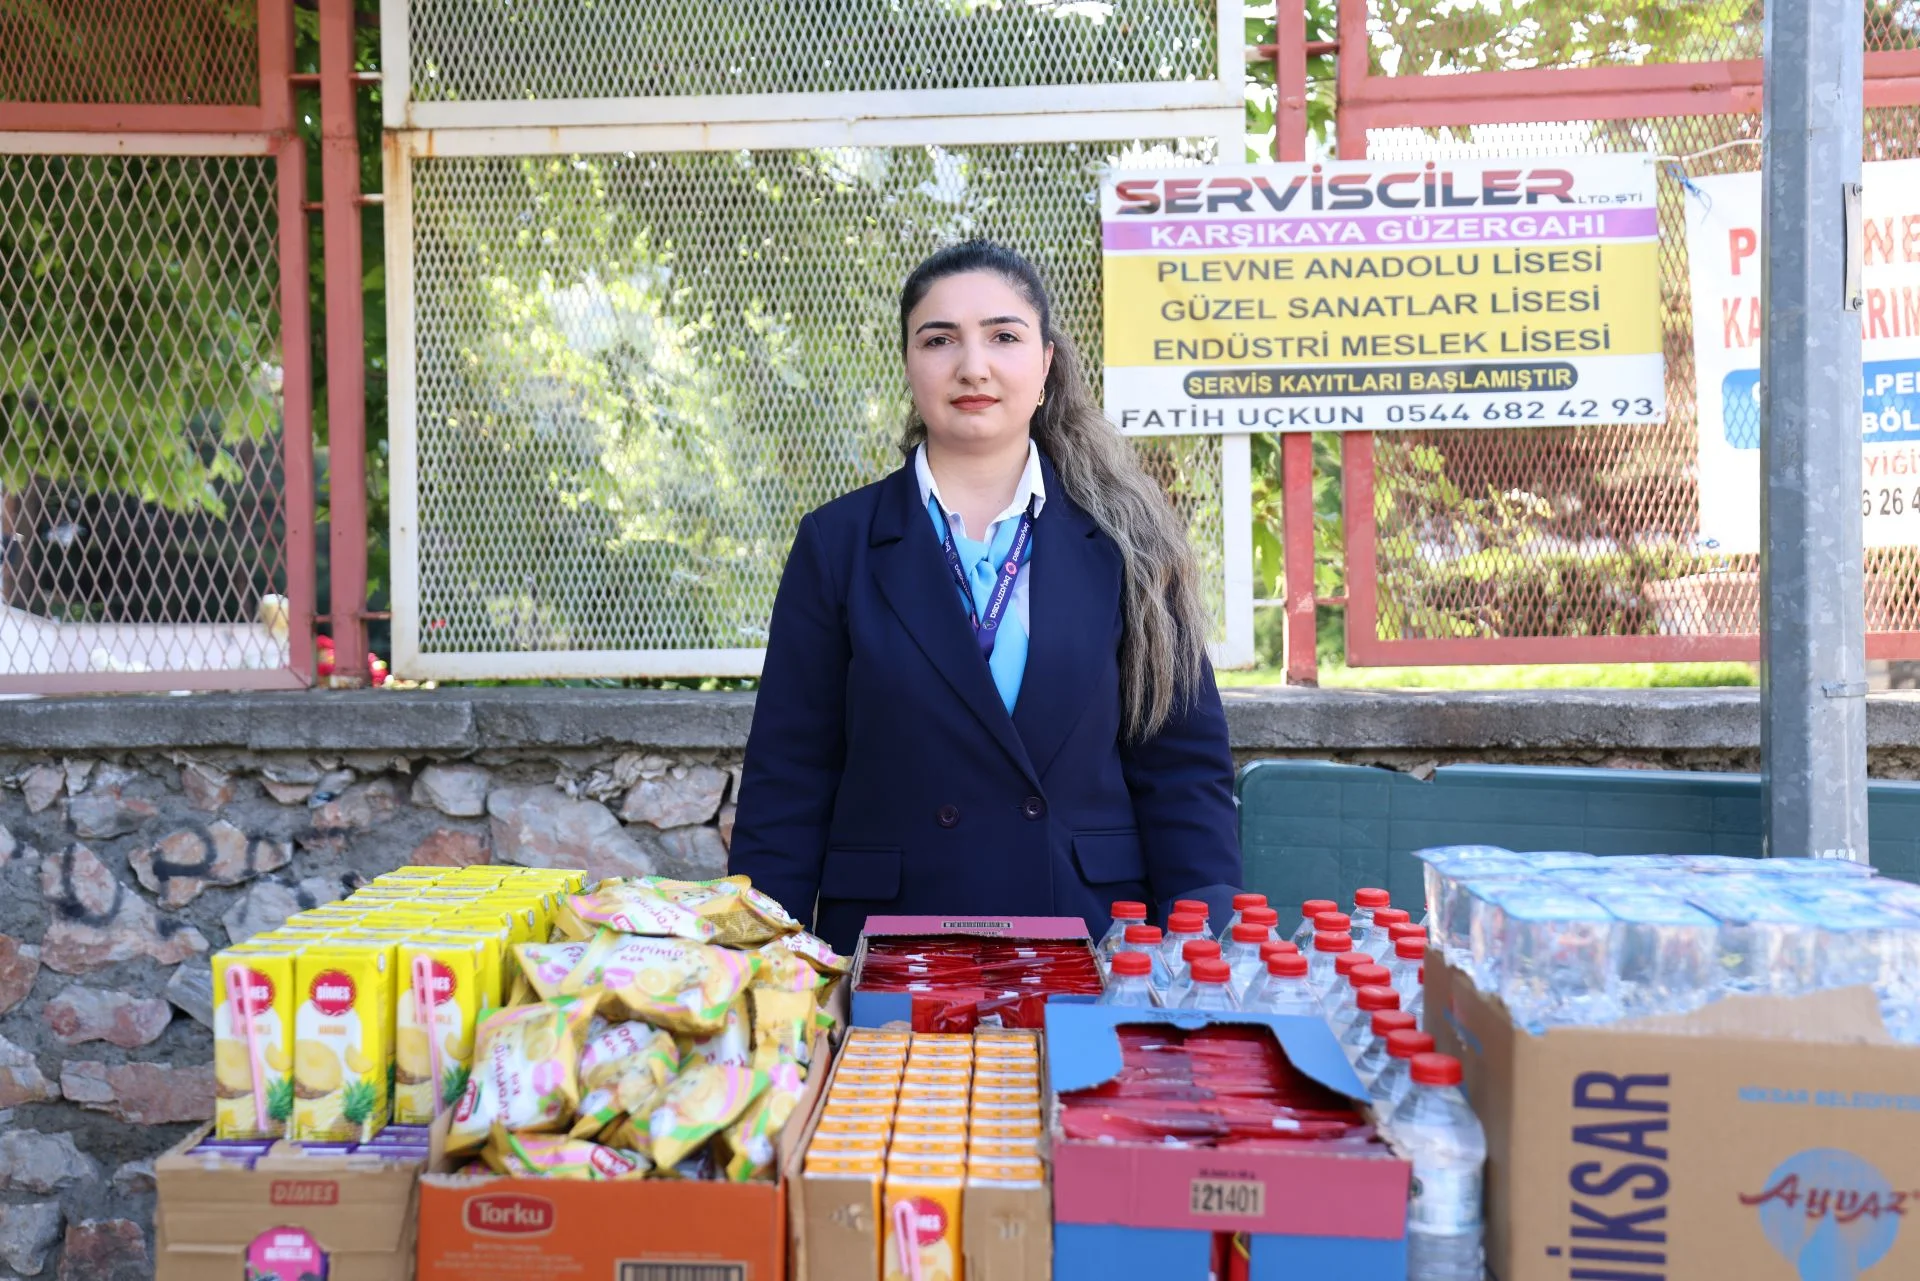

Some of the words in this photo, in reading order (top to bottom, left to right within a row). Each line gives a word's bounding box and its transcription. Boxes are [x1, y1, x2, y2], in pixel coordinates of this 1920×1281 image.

[1115, 161, 1577, 215] SERVİSCİLER
[1151, 221, 1366, 248] KARŞIKAYA
[1376, 214, 1605, 242] GÜZERGAHI
[1158, 259, 1294, 283] PLEVNE
[1304, 254, 1479, 280] ANADOLU
[1493, 245, 1601, 275] LİSESİ
[1161, 294, 1277, 321] GÜZEL
[1288, 293, 1479, 319] SANATLAR
[1491, 285, 1600, 314] LİSESİ
[1154, 331, 1328, 360] ENDÜSTRİ
[1341, 331, 1488, 357] MESLEK
[1500, 323, 1611, 353] LİSESİ
[1188, 372, 1273, 395] SERVİS
[1280, 372, 1401, 393] KAYITLARI
[1409, 368, 1572, 392] BAŞLAMIŞTIR
[1121, 404, 1224, 428] FATİH
[1238, 406, 1363, 428] UÇKUN
[1386, 403, 1471, 423] 0544
[1483, 401, 1545, 420] 682
[1557, 399, 1599, 418] 42
[1612, 398, 1653, 416] 93
[1879, 488, 1904, 515] 26
[477, 1202, 545, 1226] Torku
[1202, 1183, 1259, 1213] 21401
